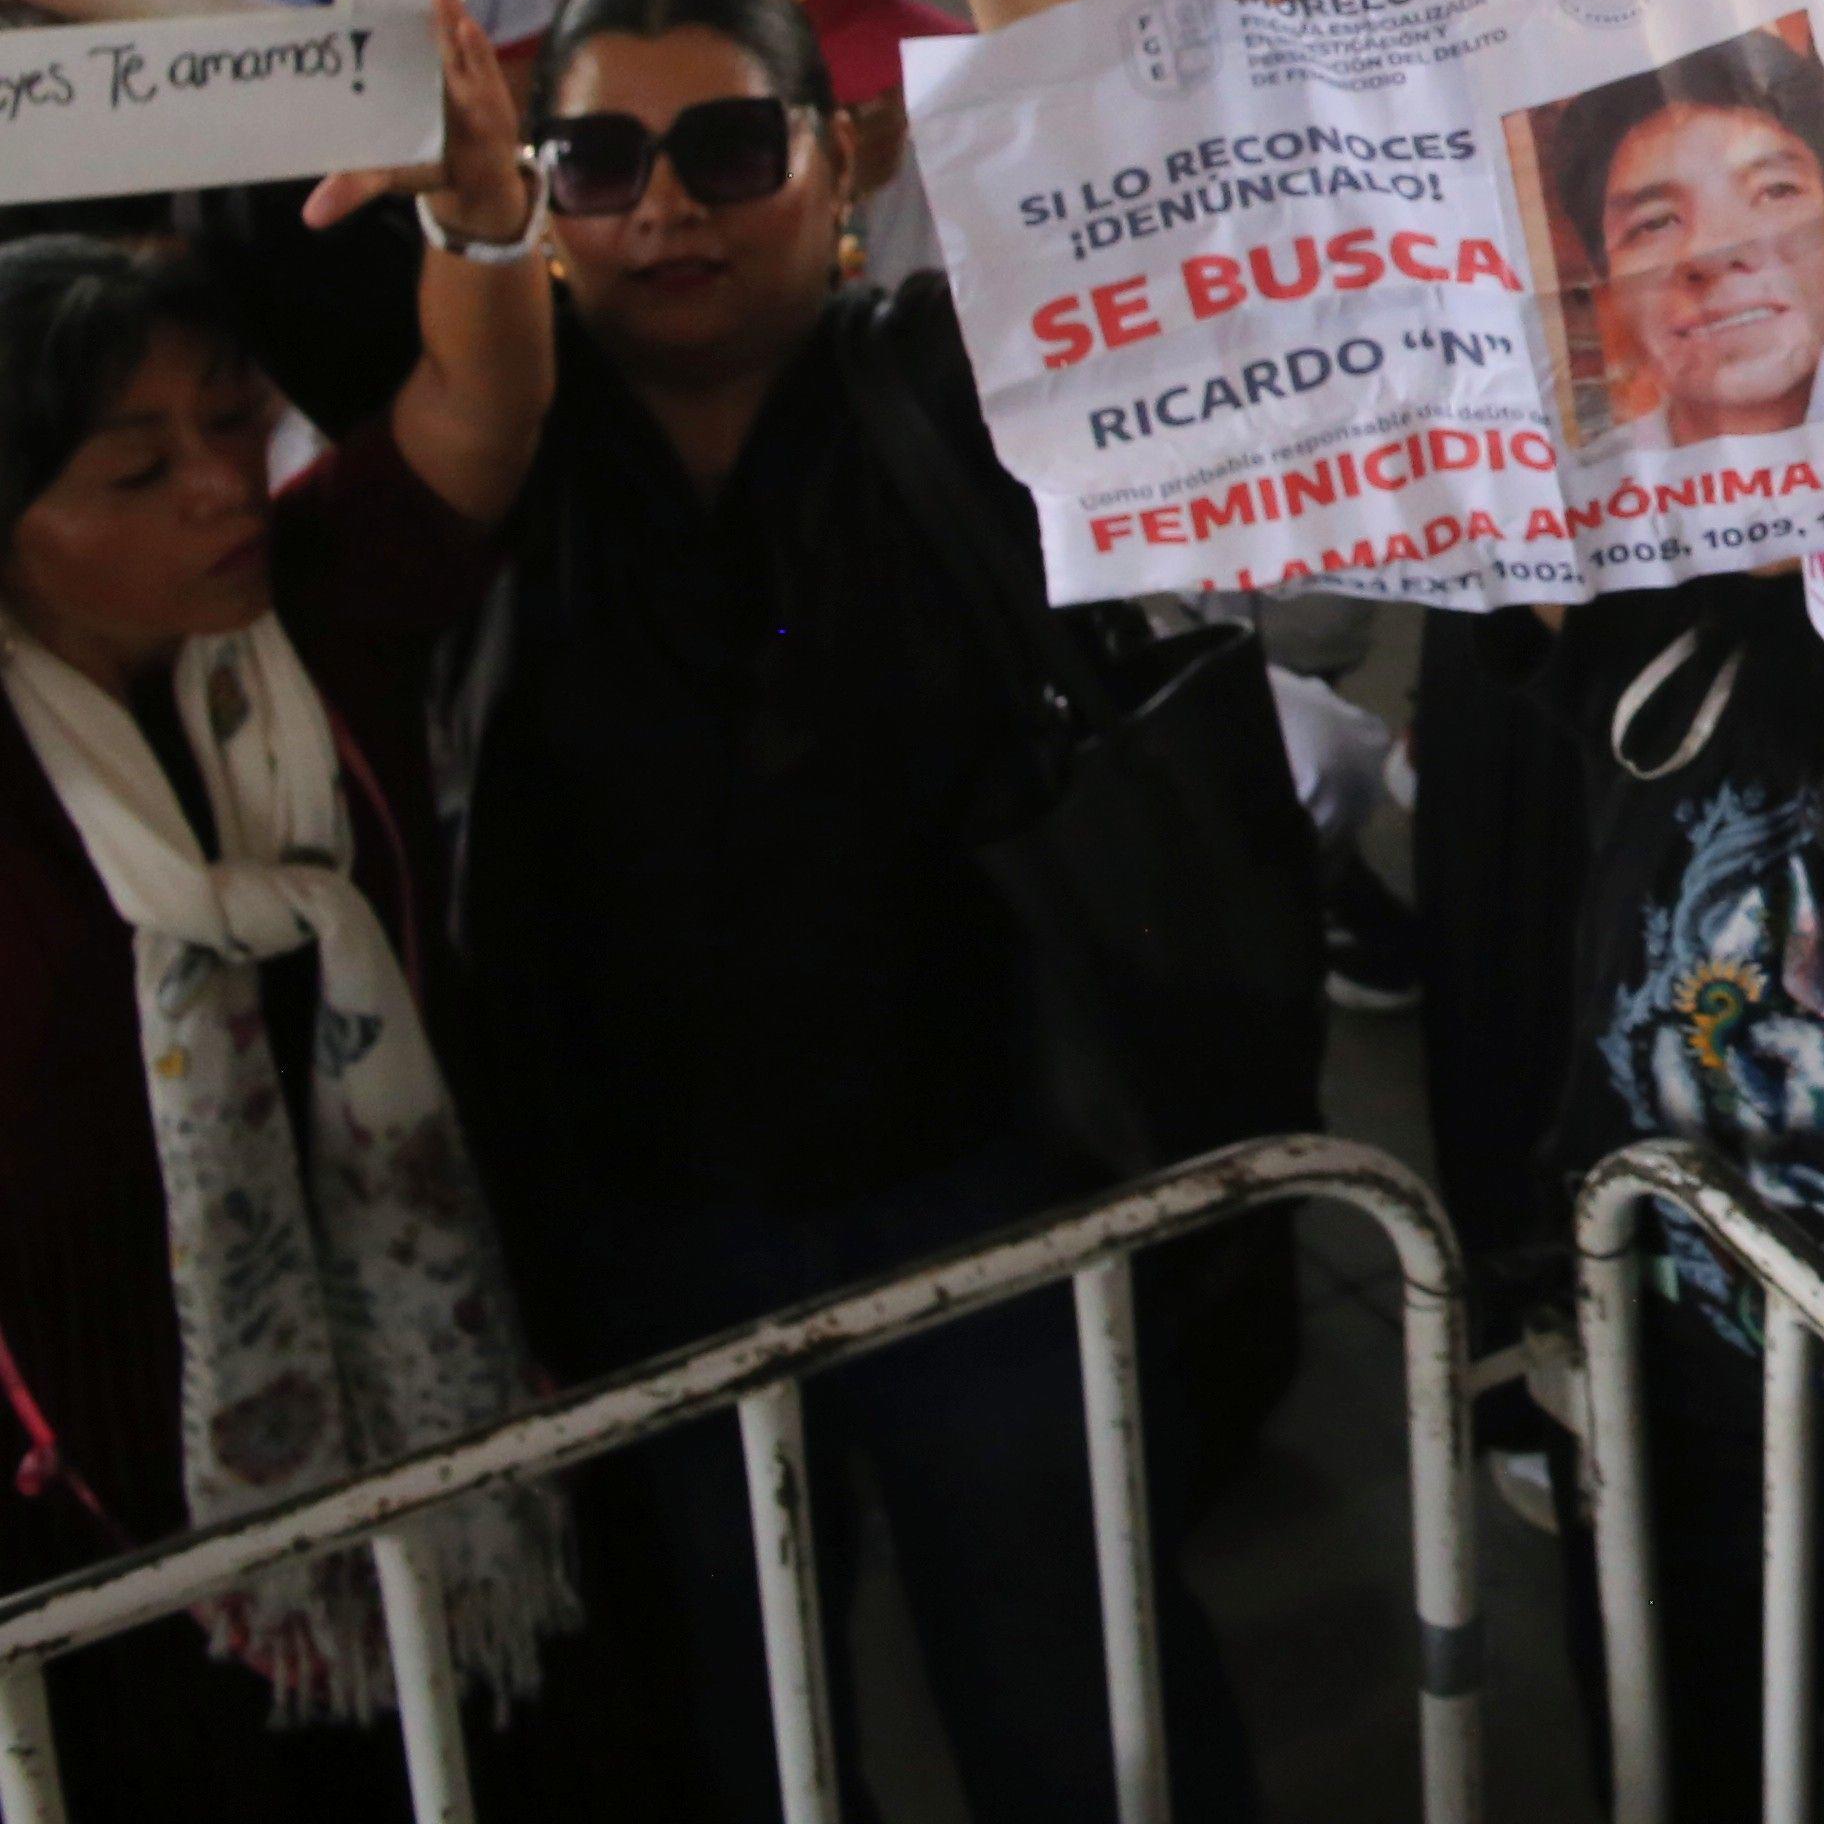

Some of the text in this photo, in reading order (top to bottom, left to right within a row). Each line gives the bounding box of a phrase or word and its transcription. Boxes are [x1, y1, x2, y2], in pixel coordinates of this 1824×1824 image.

[1020, 125, 1476, 227] SI LO RECONOCES
[1069, 166, 1444, 260] ¡DENÚNCIALO!
[1031, 227, 1525, 370] SE BUSCA
[1088, 338, 1385, 450] RICARDO
[1090, 428, 1558, 554] FEMINICIDIO
[1201, 461, 1824, 592] AMADA ANÓNIMA
